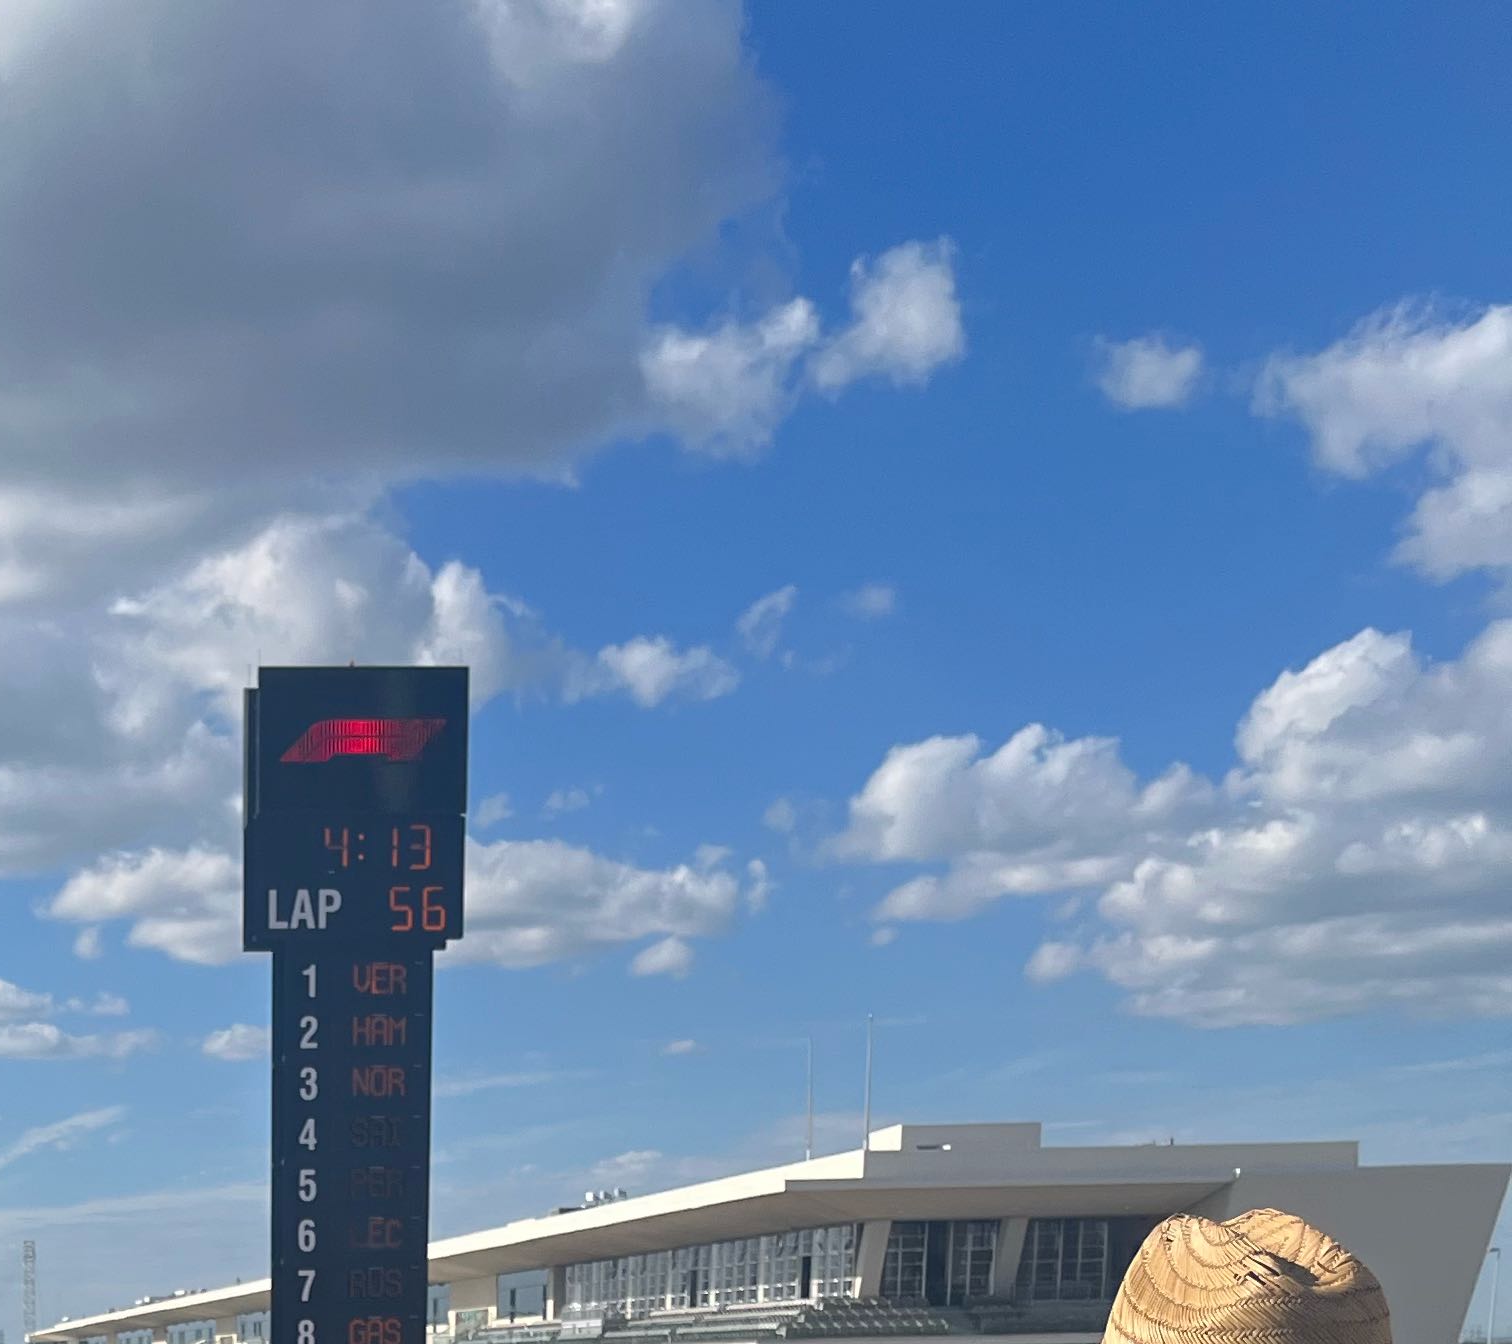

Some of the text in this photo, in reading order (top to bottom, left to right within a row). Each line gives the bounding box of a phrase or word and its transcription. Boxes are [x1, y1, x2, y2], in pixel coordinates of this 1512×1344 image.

[323, 824, 432, 870] 4:13
[267, 886, 446, 932] LAP 56
[301, 964, 408, 998] 1 VER
[299, 1015, 408, 1049] 2 HAM
[299, 1066, 406, 1101] 3 NOR
[298, 1118, 317, 1151] 4
[298, 1168, 317, 1202] 5
[297, 1219, 316, 1252] 6
[297, 1269, 316, 1303] 7
